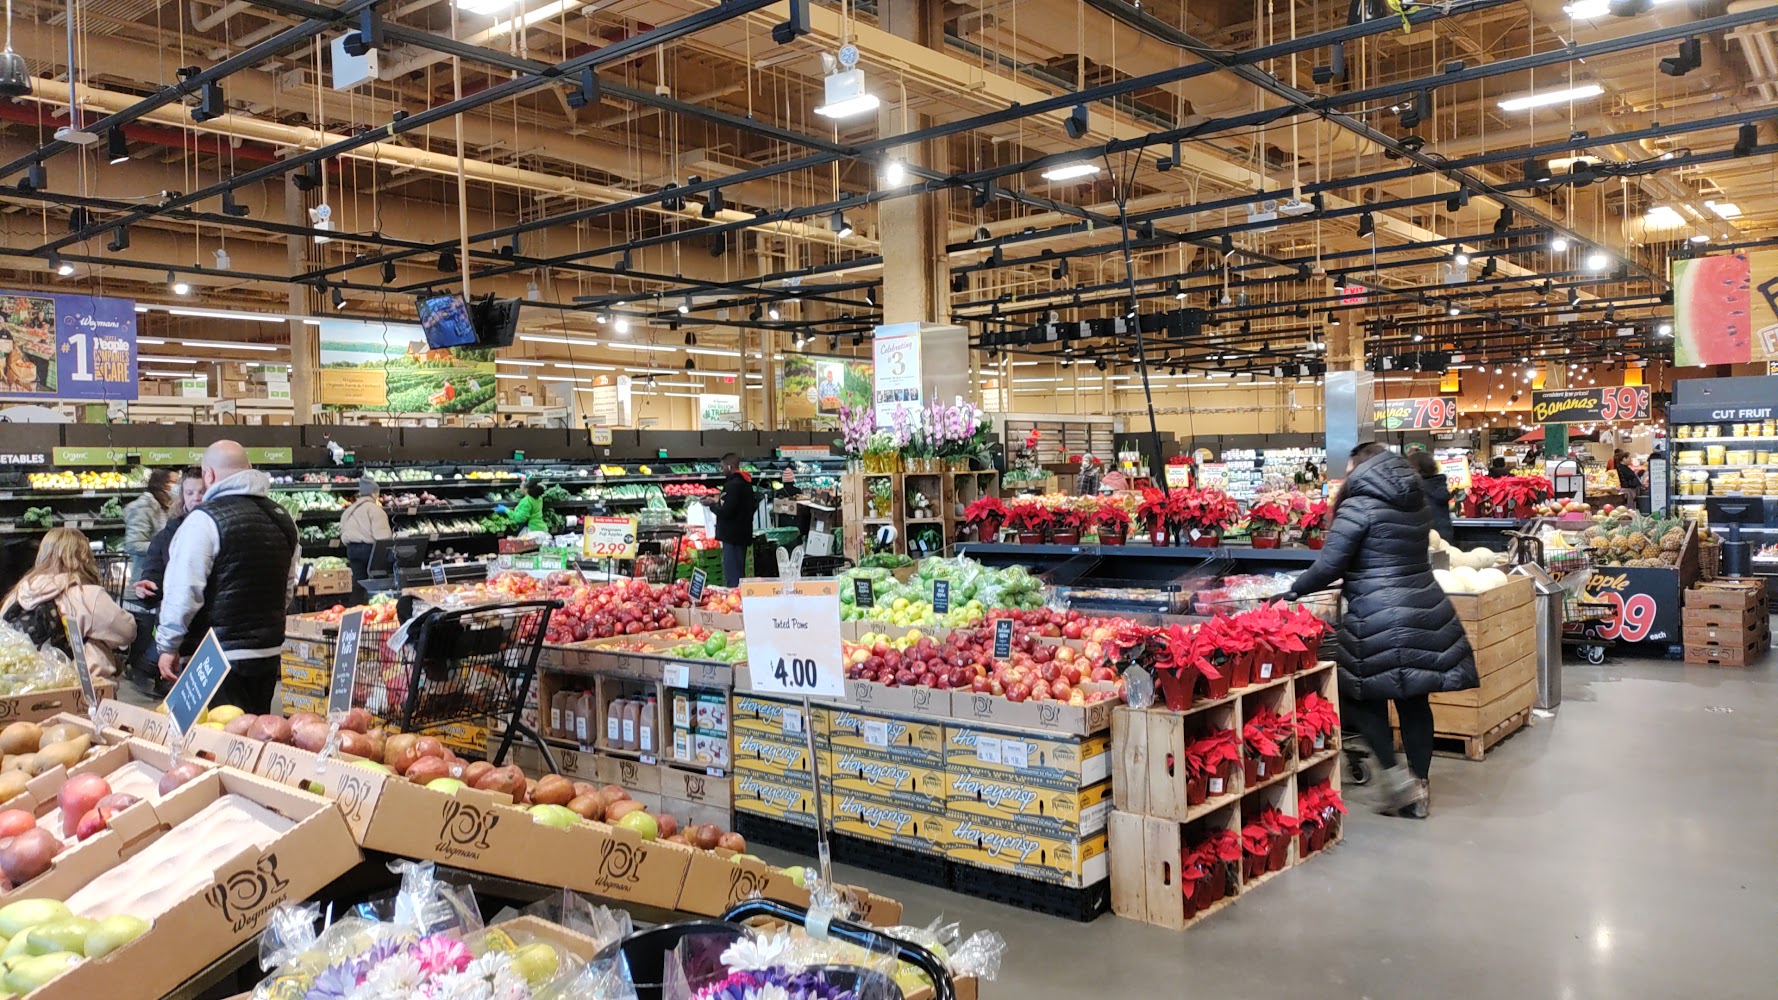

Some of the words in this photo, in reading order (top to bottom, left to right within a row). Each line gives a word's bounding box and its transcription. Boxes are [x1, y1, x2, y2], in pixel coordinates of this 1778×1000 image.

[79, 315, 120, 331] Wegmans
[93, 337, 130, 353] People
[880, 342, 913, 355] Celebrating
[61, 333, 93, 382] #1
[93, 350, 130, 363] COMPANIES
[104, 362, 131, 382] CARE
[1534, 397, 1598, 421] Bananas
[1601, 386, 1649, 420] 59¢
[1413, 398, 1456, 428] 79¢
[1638, 410, 1647, 418] lb.
[1712, 409, 1736, 419] CUT
[1739, 408, 1772, 418] FRUIT
[63, 451, 88, 462] Organic
[107, 451, 126, 462] Organ
[149, 451, 172, 461] Organic
[264, 450, 285, 460] Organic
[592, 541, 626, 555] $2.99
[772, 618, 790, 629] Tinted
[792, 618, 808, 629] Poms
[1649, 631, 1666, 640] each
[738, 697, 783, 724] Honeyc
[835, 711, 906, 744] Honisp
[739, 735, 801, 768] Honeycrisp
[837, 753, 910, 789] Honeycrisp
[739, 776, 801, 809] Honeycrisp
[952, 773, 1037, 813] Honeycrisp
[838, 796, 911, 832] Honeycrisp
[952, 821, 1039, 862] Honeycrisp
[231, 892, 287, 934] Wegmans
